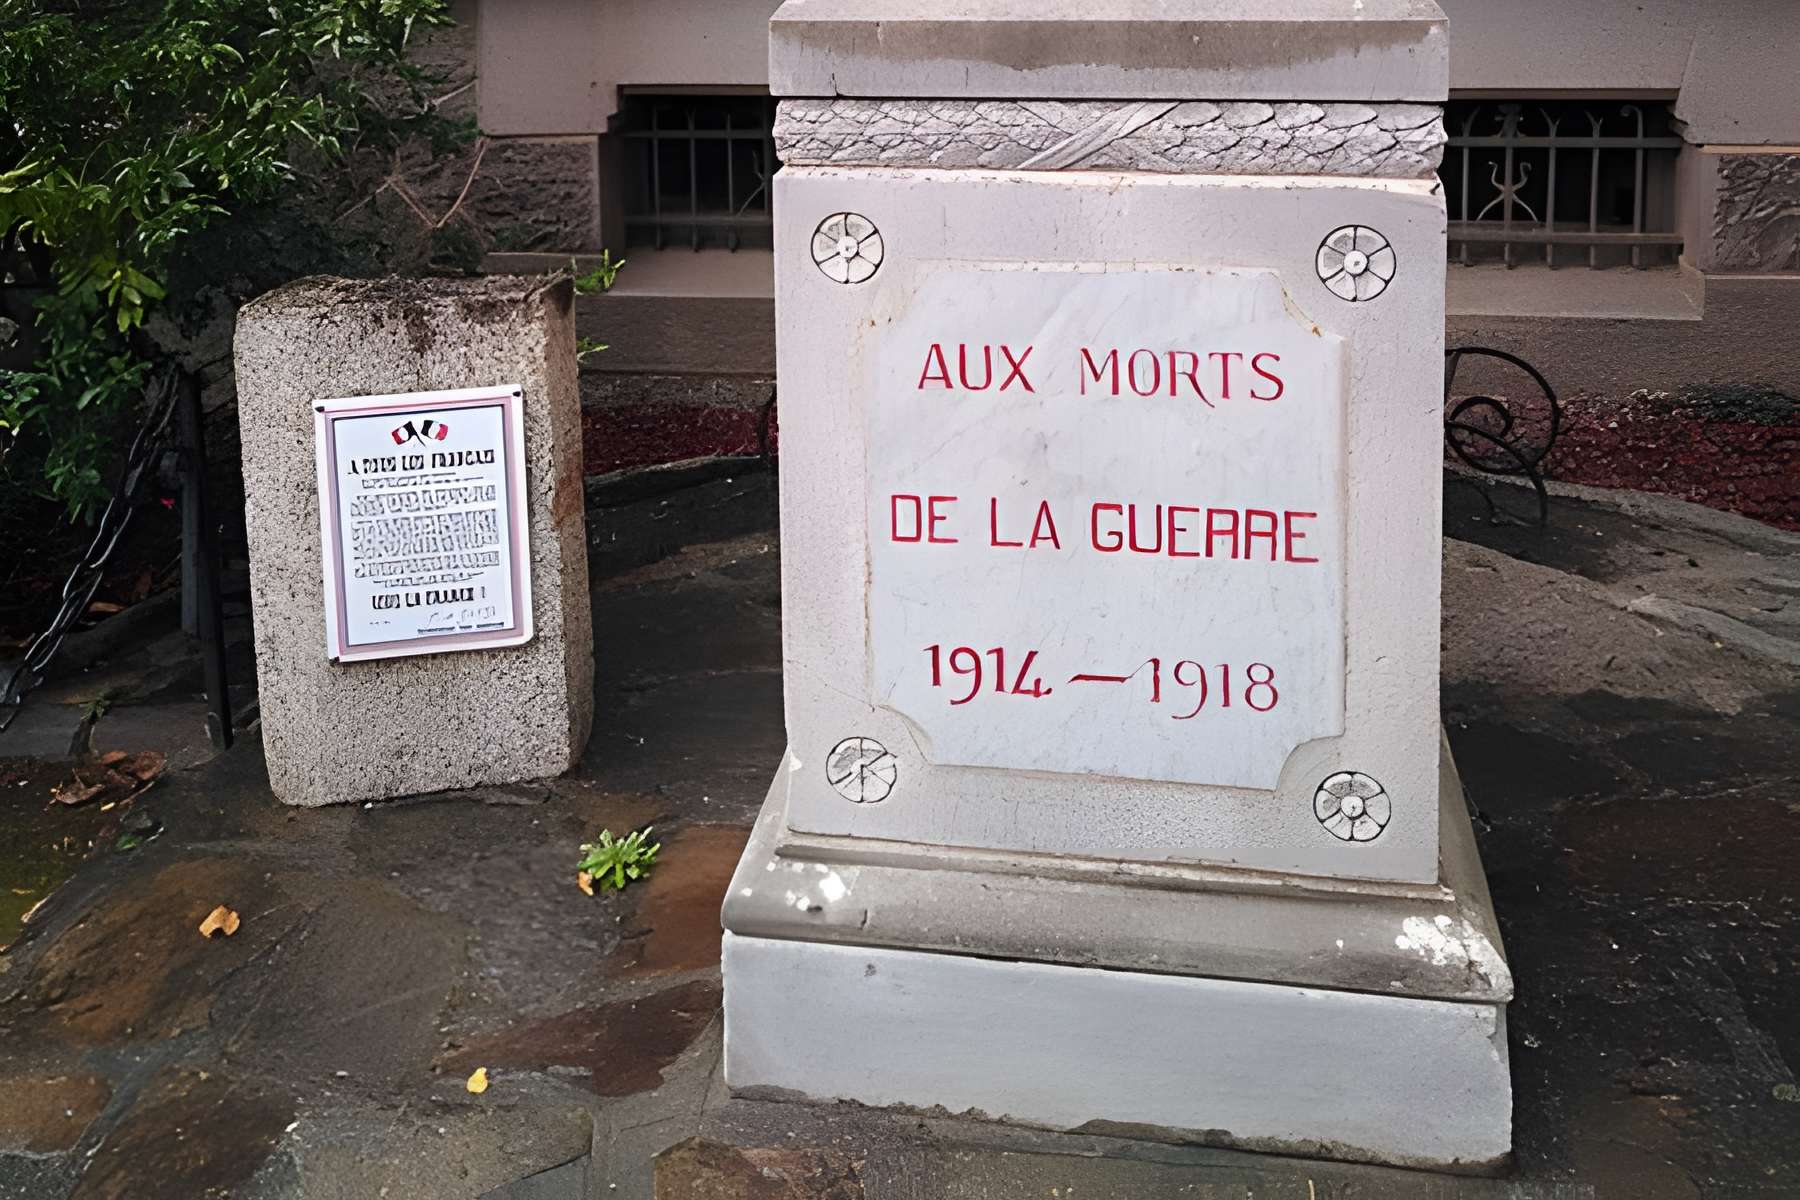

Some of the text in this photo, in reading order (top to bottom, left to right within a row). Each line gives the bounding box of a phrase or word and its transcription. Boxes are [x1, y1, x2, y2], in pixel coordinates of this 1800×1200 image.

[917, 342, 1285, 409] AUX MORTS
[890, 493, 1320, 564] DE LA GUERRE
